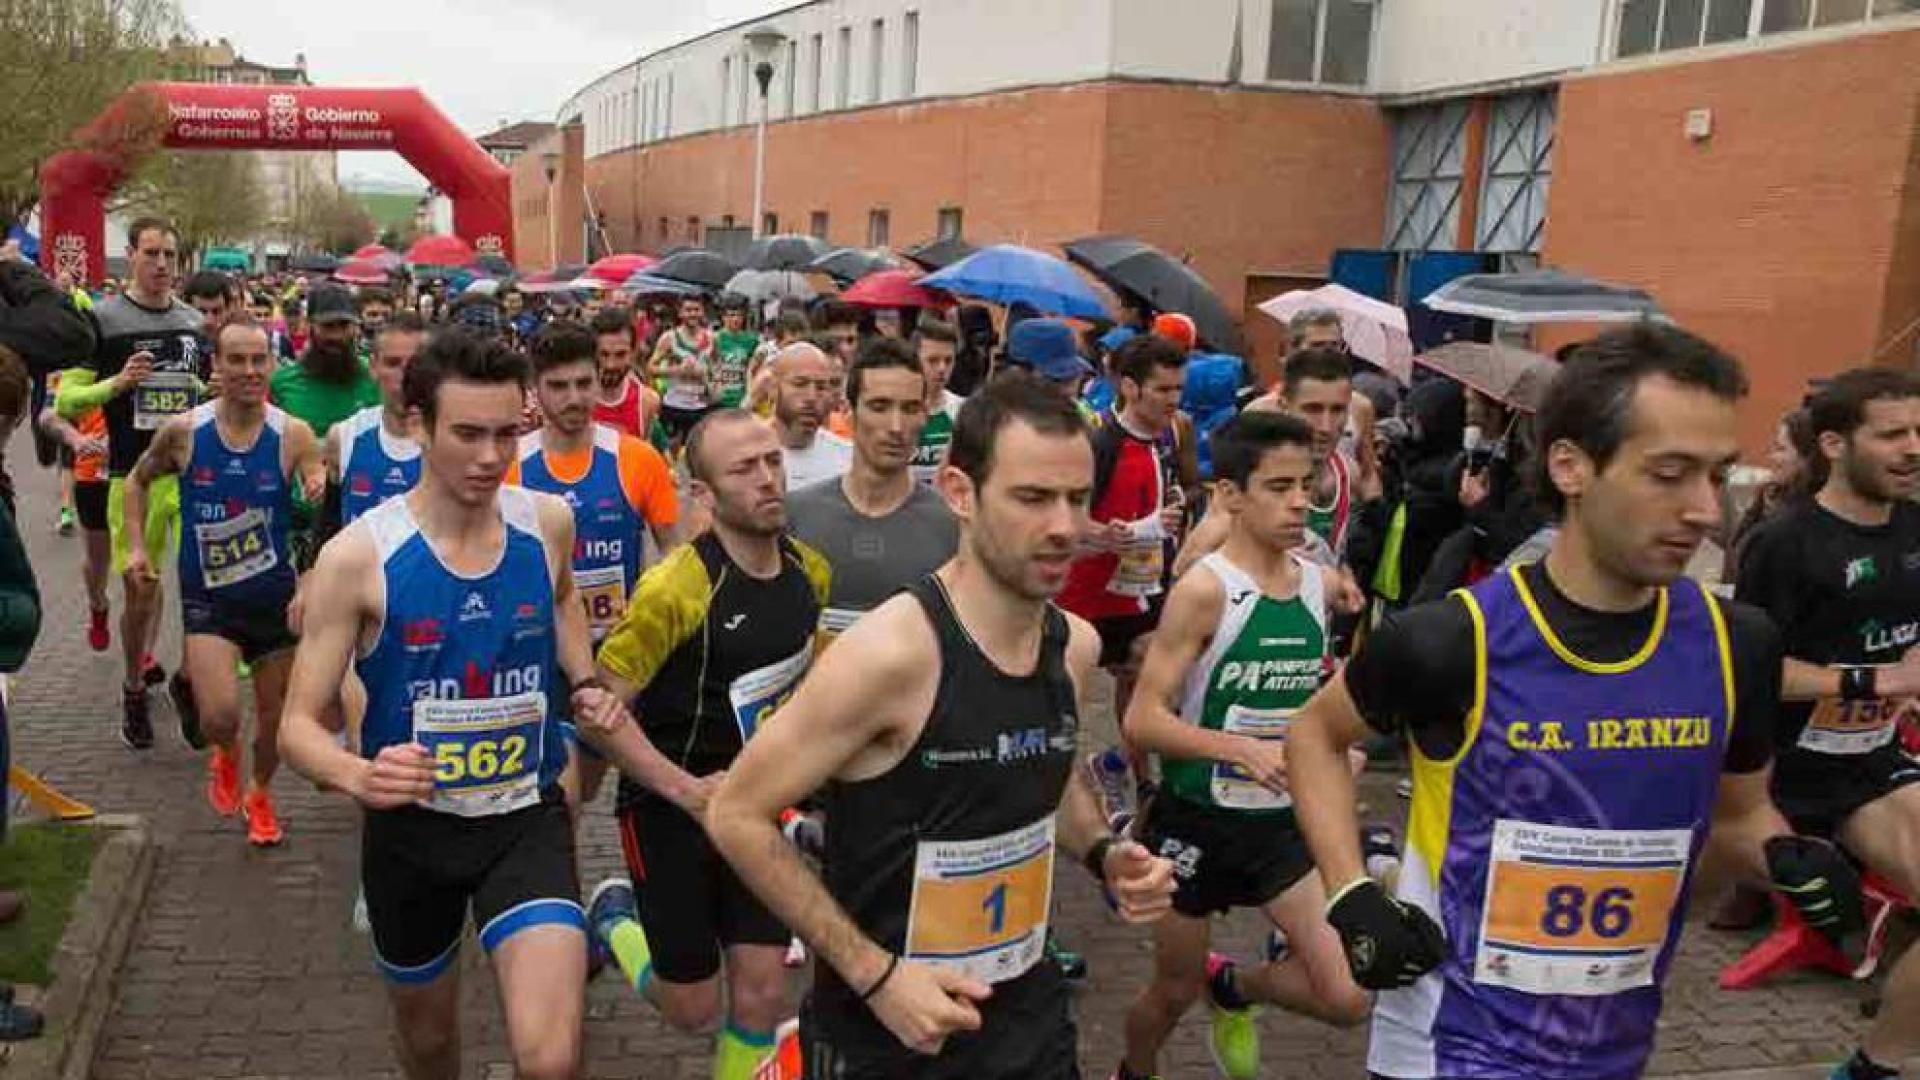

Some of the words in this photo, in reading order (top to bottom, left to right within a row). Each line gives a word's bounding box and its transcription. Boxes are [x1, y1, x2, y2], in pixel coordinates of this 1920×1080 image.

[305, 107, 380, 123] Gobierno
[1216, 660, 1263, 692] PA
[1507, 722, 1575, 751] C.A.
[1587, 717, 1711, 749] IRANZU
[434, 735, 526, 782] 562
[982, 882, 1009, 935] 1
[1541, 884, 1634, 939] 86
